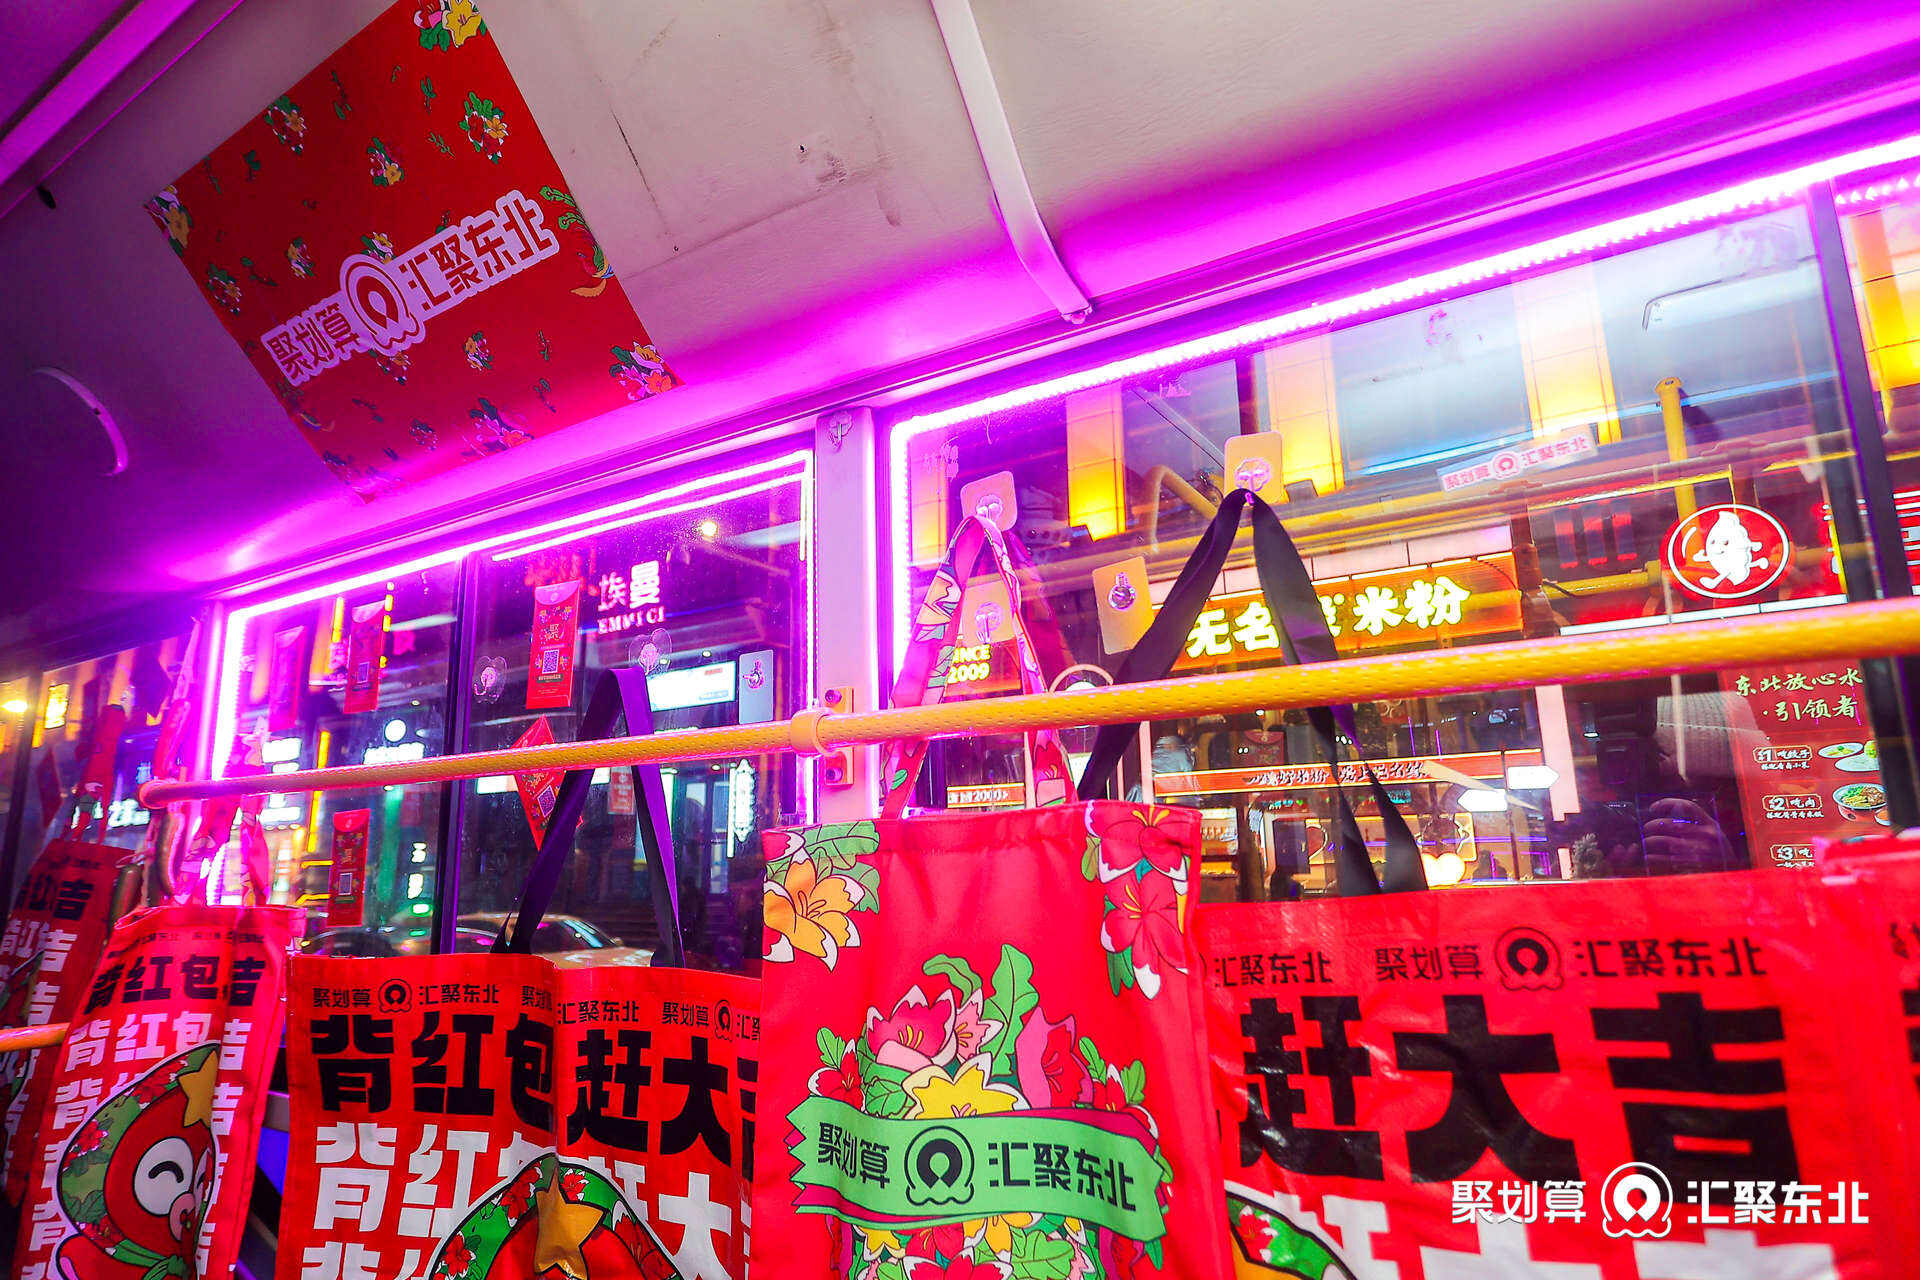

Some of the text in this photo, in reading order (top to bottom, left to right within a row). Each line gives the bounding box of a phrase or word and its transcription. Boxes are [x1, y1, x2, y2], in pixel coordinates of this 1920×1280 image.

[266, 198, 553, 380] 聚划算 汇聚东北
[1214, 935, 1769, 988] 汇聚东北 聚划算 汇聚东北
[313, 987, 372, 1009] 聚划算
[419, 983, 500, 1006] 汇聚东北
[557, 999, 640, 1025] 汇聚东北
[662, 1002, 710, 1028] 聚划算
[817, 1121, 1138, 1213] 聚划算 汇聚东北
